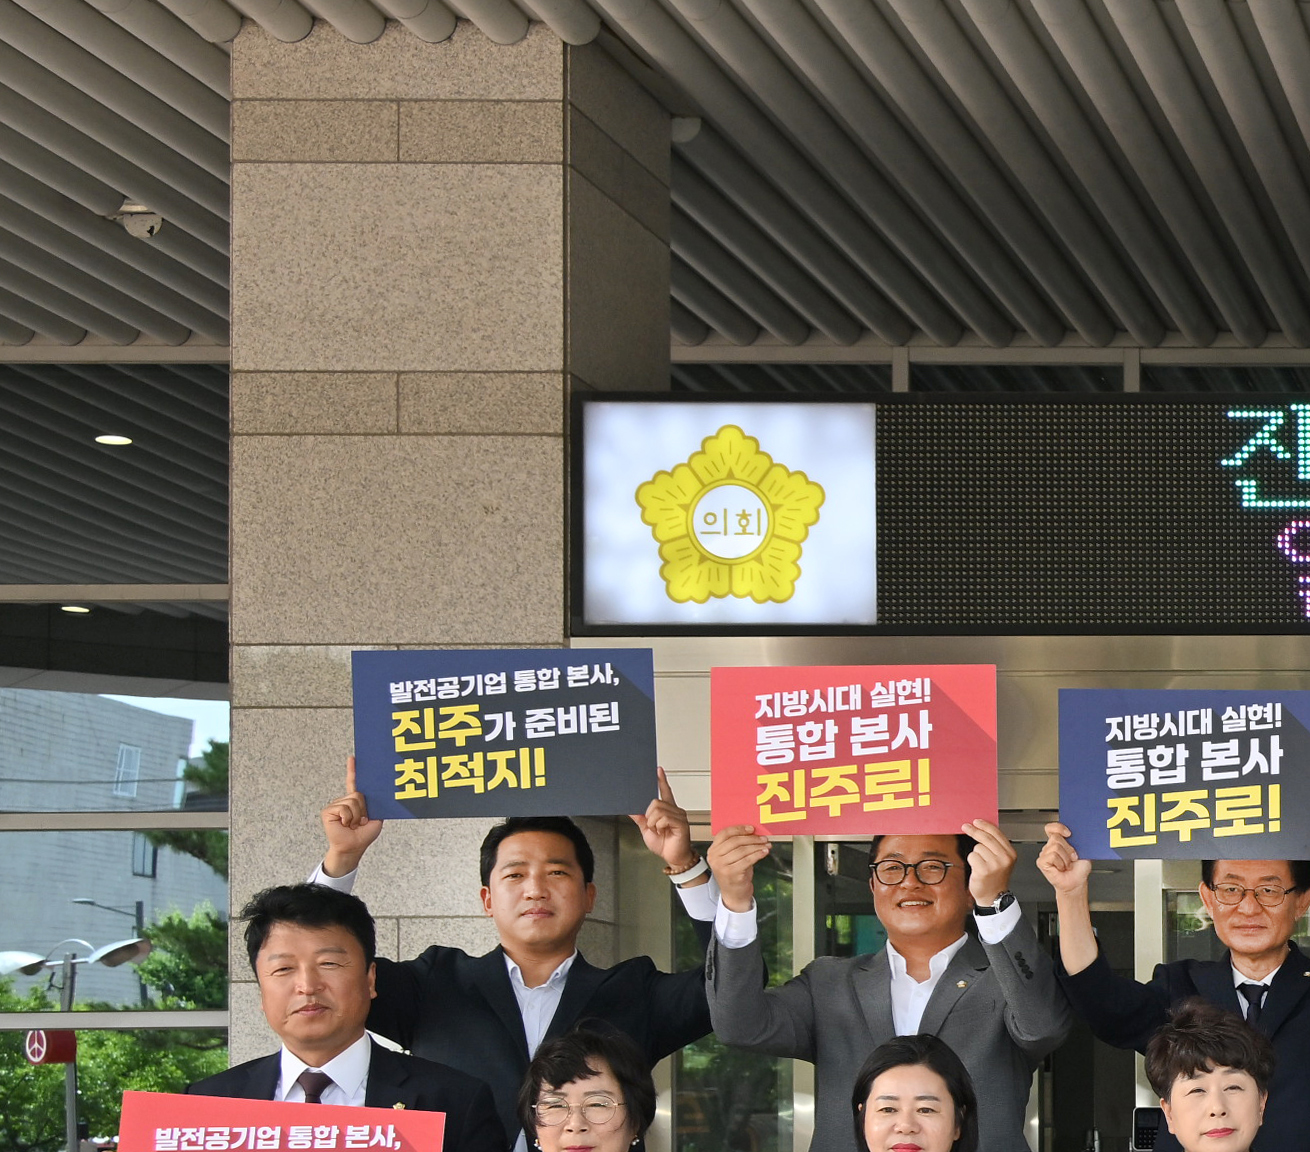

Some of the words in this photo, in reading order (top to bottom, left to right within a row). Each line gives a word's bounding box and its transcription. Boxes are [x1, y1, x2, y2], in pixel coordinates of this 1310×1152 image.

[700, 508, 761, 536] 의회
[390, 672, 506, 703] 발전공기업
[514, 668, 560, 692] 통합
[567, 663, 619, 687] 본사,
[755, 684, 861, 719] 지방시대
[871, 678, 930, 708] 실현!
[392, 704, 516, 752] 진주가
[525, 702, 619, 738] 준비된
[756, 720, 838, 765] 통합
[850, 710, 932, 756] 본사
[1106, 708, 1212, 742] 지방시대
[1222, 703, 1281, 732] 실현!
[395, 748, 545, 799] 최적지!
[1106, 743, 1189, 789] 통합
[1201, 735, 1283, 781] 본사
[757, 759, 930, 824] 진주로!
[1107, 784, 1280, 848] 진주로!
[156, 1126, 281, 1151] 발전공기업
[288, 1126, 339, 1148] 통합
[346, 1125, 400, 1150] 본사,
